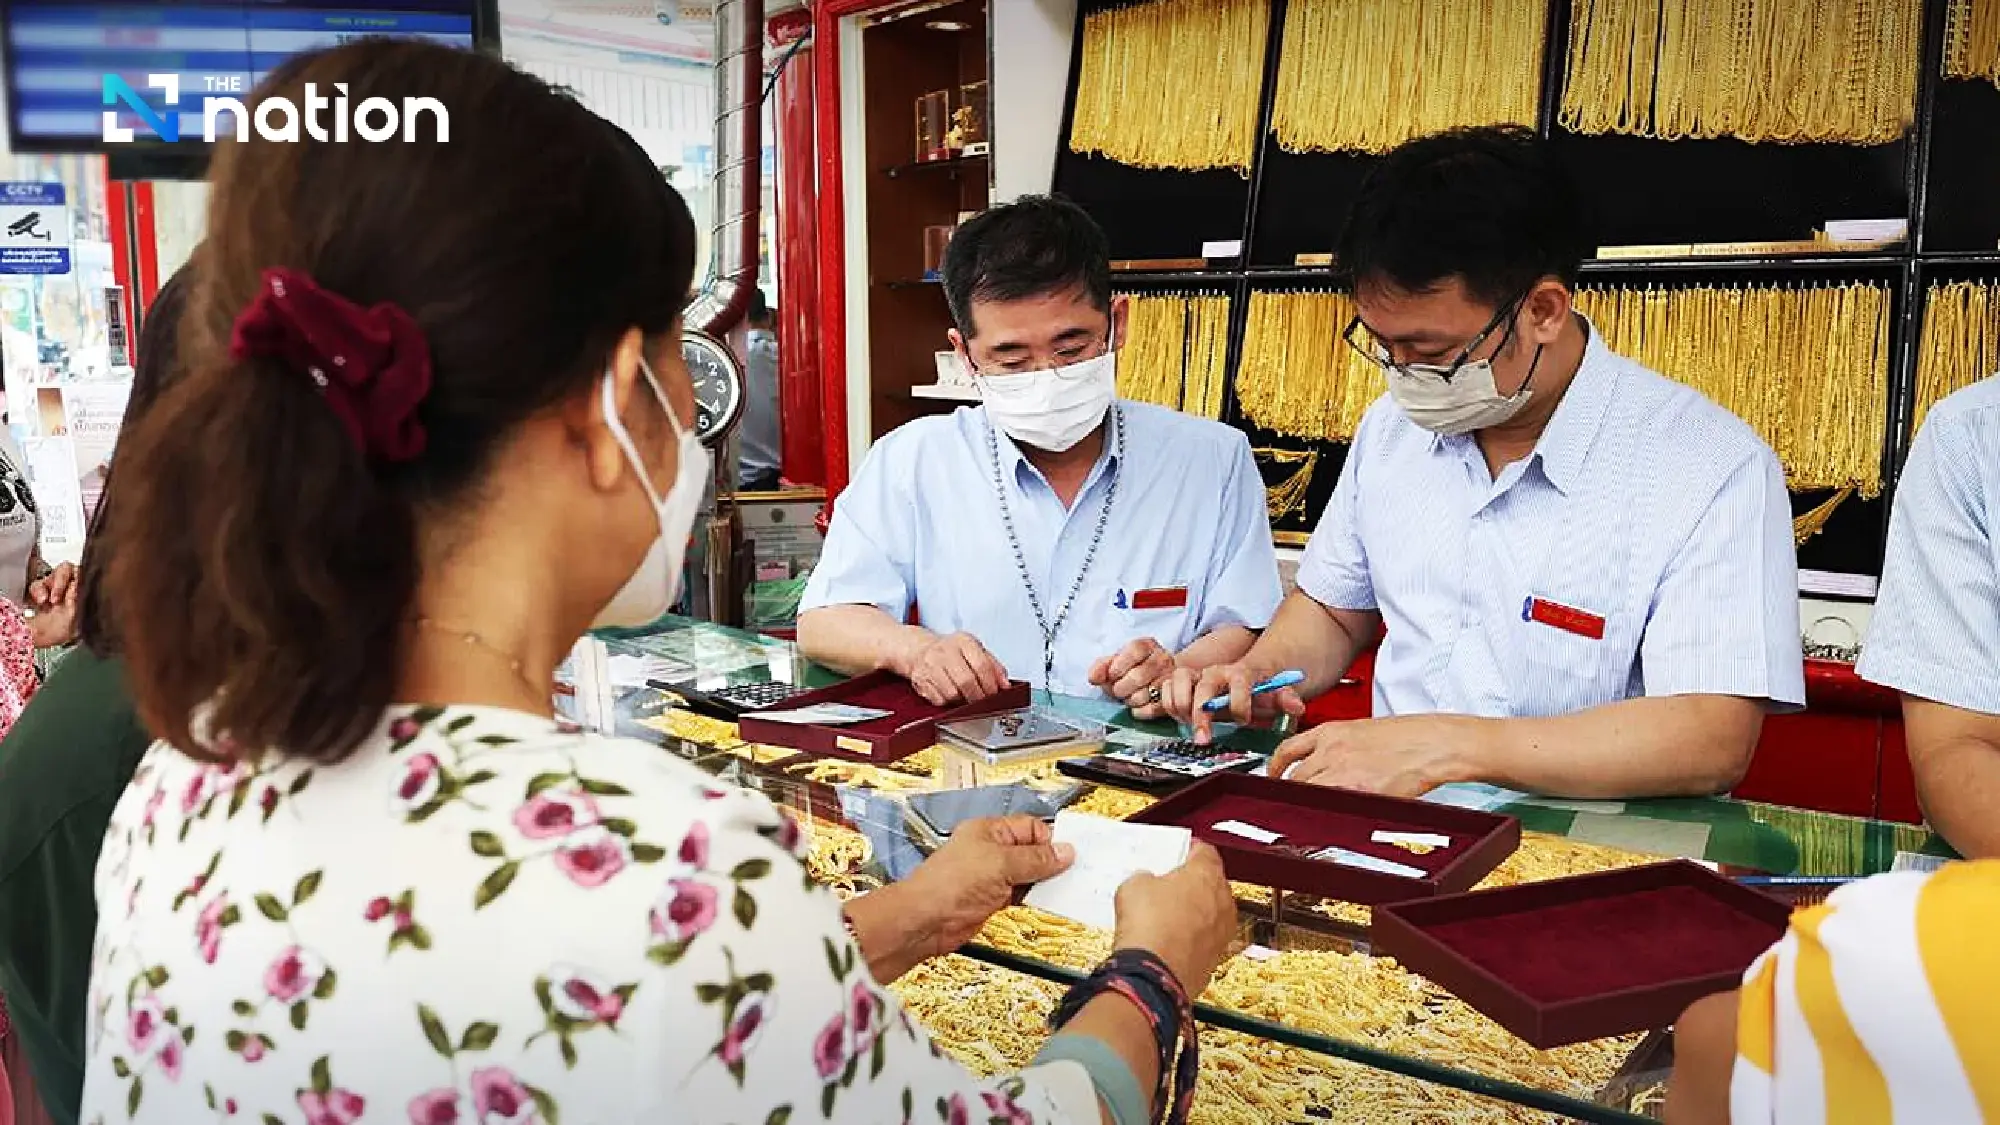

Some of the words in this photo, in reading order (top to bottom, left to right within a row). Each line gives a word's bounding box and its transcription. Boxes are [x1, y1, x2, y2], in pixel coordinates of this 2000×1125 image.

[6, 184, 43, 196] CCTV
[695, 350, 701, 364] 1
[708, 361, 718, 377] 2
[716, 380, 727, 394] 3
[699, 415, 710, 430] 5
